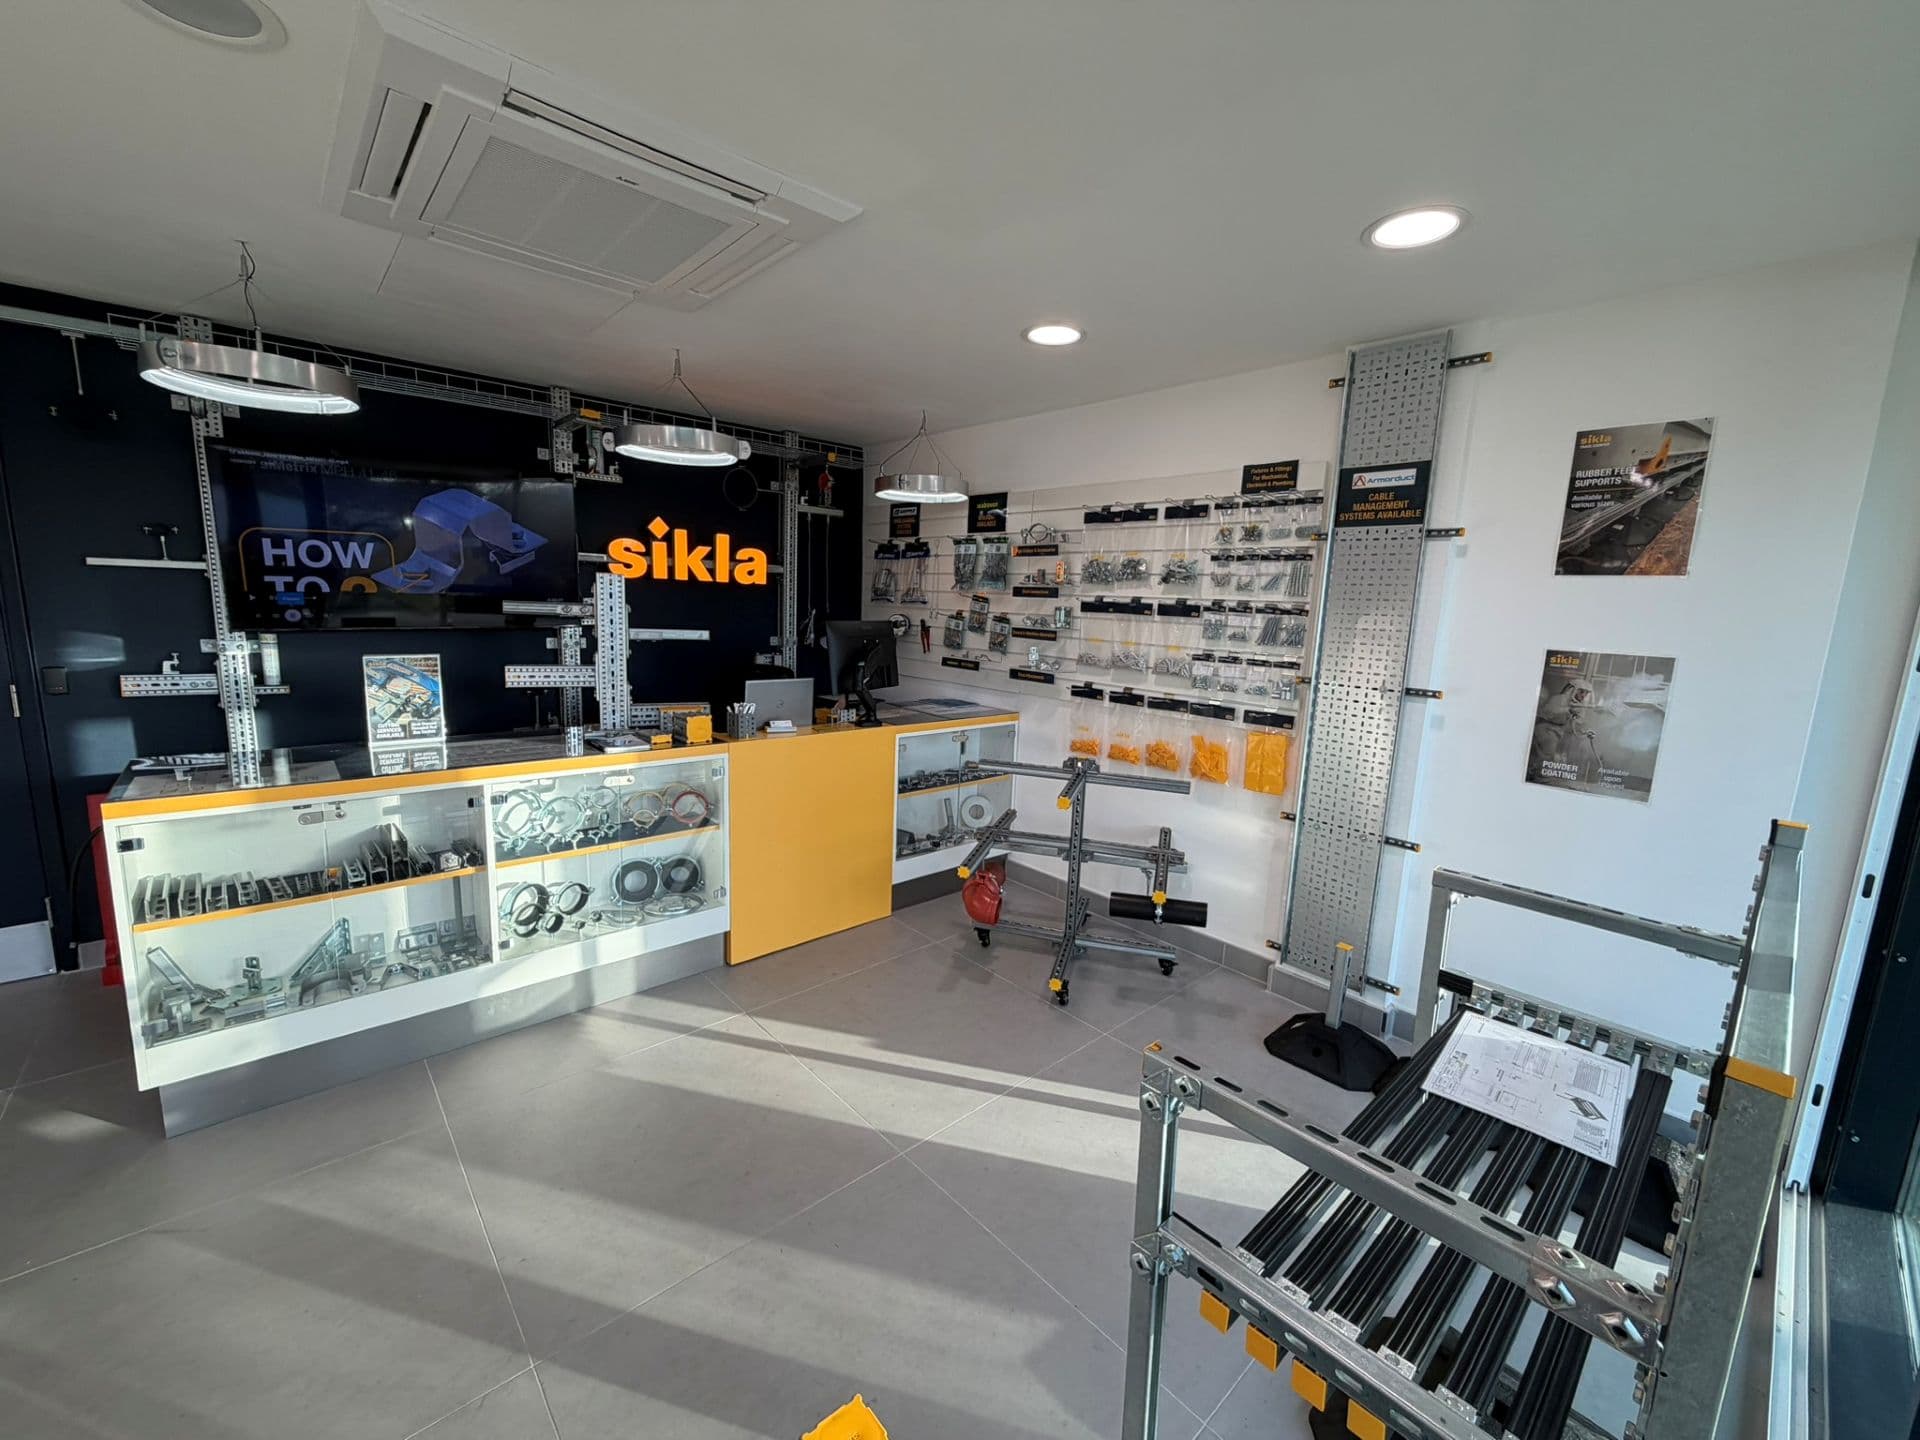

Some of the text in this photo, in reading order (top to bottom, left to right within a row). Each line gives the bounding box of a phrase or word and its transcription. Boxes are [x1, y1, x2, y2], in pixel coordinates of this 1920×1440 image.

[1580, 434, 1612, 445] sikla
[1575, 467, 1612, 478] RUBBER
[1367, 474, 1416, 484] Armorduct
[1574, 476, 1622, 488] SUPPORTS
[1368, 492, 1395, 501] CABLE
[1571, 493, 1603, 502] Available
[1352, 500, 1409, 511] MANAGEMENT
[1339, 509, 1422, 521] SYSTEMS AVAILABLE
[261, 537, 375, 569] HOW
[607, 515, 768, 585] sikla
[1550, 654, 1580, 666] sikla
[1542, 760, 1579, 773] POWDER
[1598, 767, 1630, 777] Available
[1541, 768, 1577, 781] COATING
